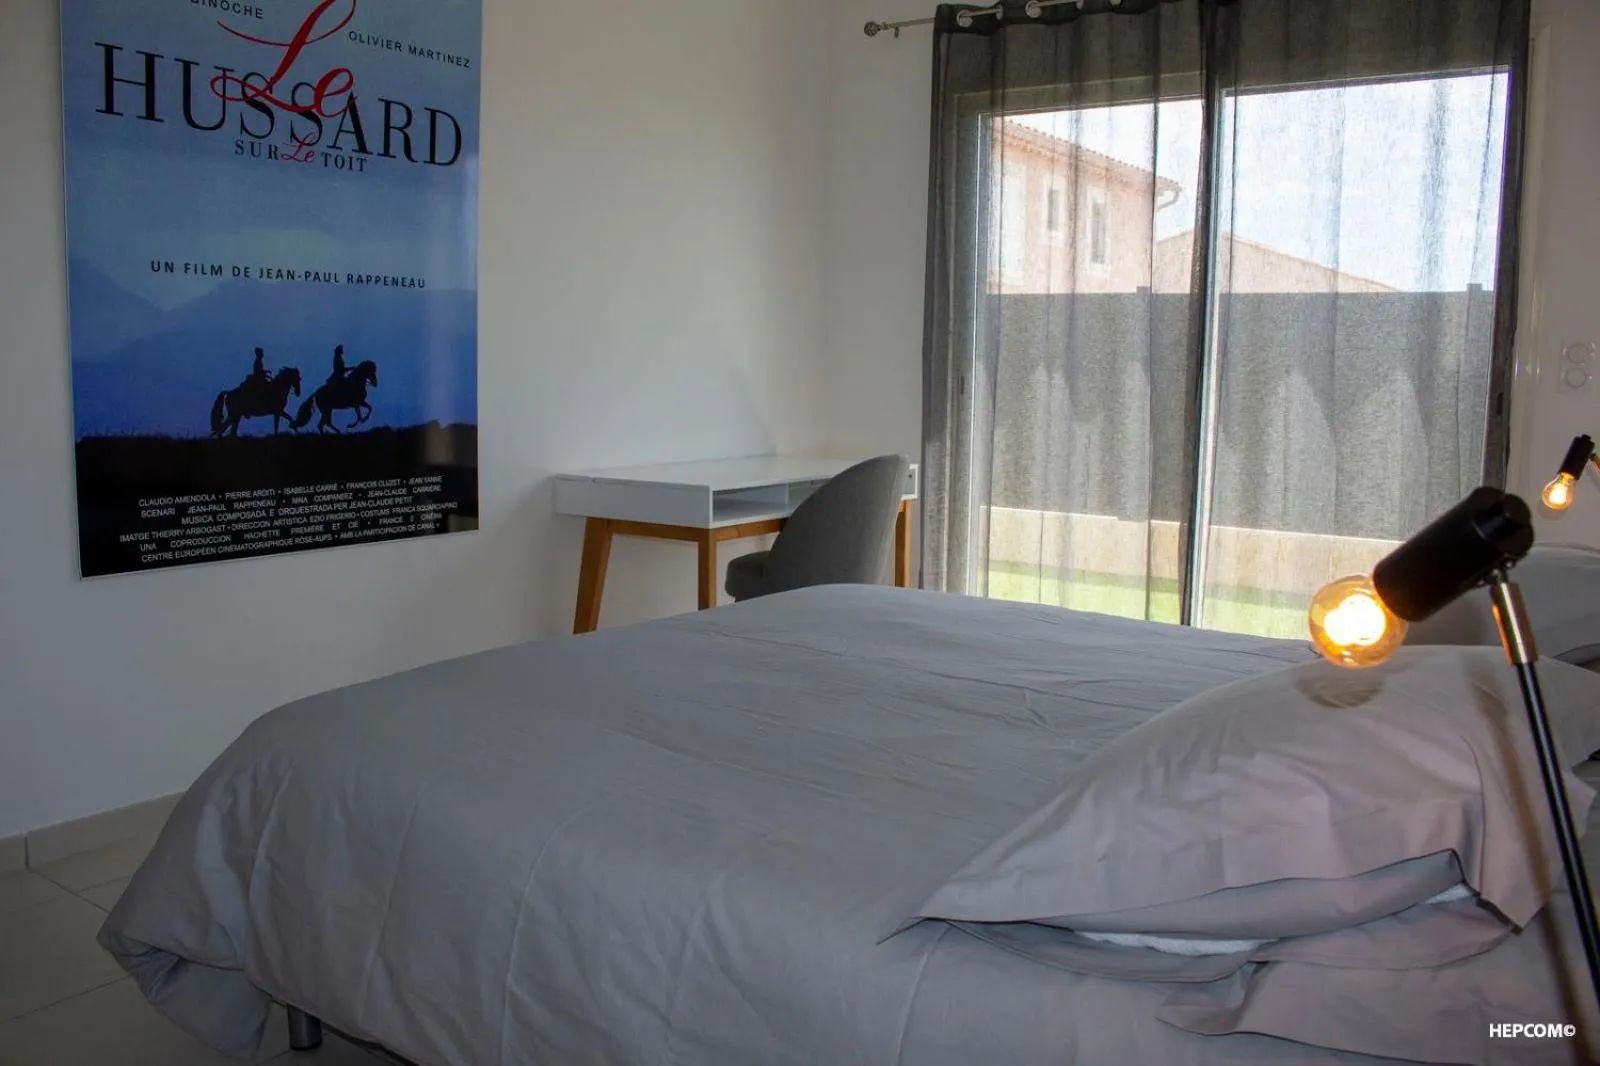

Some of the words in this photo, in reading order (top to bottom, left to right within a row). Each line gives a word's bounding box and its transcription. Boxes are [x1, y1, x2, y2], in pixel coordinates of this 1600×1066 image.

[210, 0, 356, 118] Le
[348, 30, 402, 52] OLIVIER
[408, 44, 472, 68] MARTINEZ
[95, 42, 462, 167] HUSSARD
[234, 139, 279, 161] SUR
[281, 132, 316, 163] Le
[321, 151, 368, 172] TOIT
[151, 260, 175, 273] UN
[184, 262, 223, 277] FILM
[232, 265, 251, 278] DE
[259, 267, 340, 284] JEAN-PAUL
[347, 273, 426, 289] RAPPENEAU
[138, 497, 173, 507] CLAUDIO
[174, 493, 216, 504] AMENDOLA
[225, 490, 252, 500] PIERRE
[283, 485, 314, 495] ISABELLE
[408, 477, 423, 486] JEAN
[187, 504, 226, 514] JEAN-PAUL
[233, 500, 276, 510] RAPPENEAU
[292, 496, 308, 504] NINA
[368, 488, 408, 498] JEAN-CLAUDE
[216, 510, 267, 522] COMPOSADA
[269, 508, 275, 517] E
[278, 503, 333, 514] ORQUESTRADA
[334, 502, 348, 511] PER
[348, 498, 394, 510] JEAN-CLAUDE
[395, 496, 412, 505] PETIT
[140, 542, 157, 552] UNA
[244, 529, 280, 540] HACHETTE
[332, 522, 340, 530] ET
[379, 516, 403, 525] FRANCE
[151, 529, 184, 538] THIERRY
[186, 524, 226, 535] ARBOGAST
[141, 552, 174, 562] CENTRE
